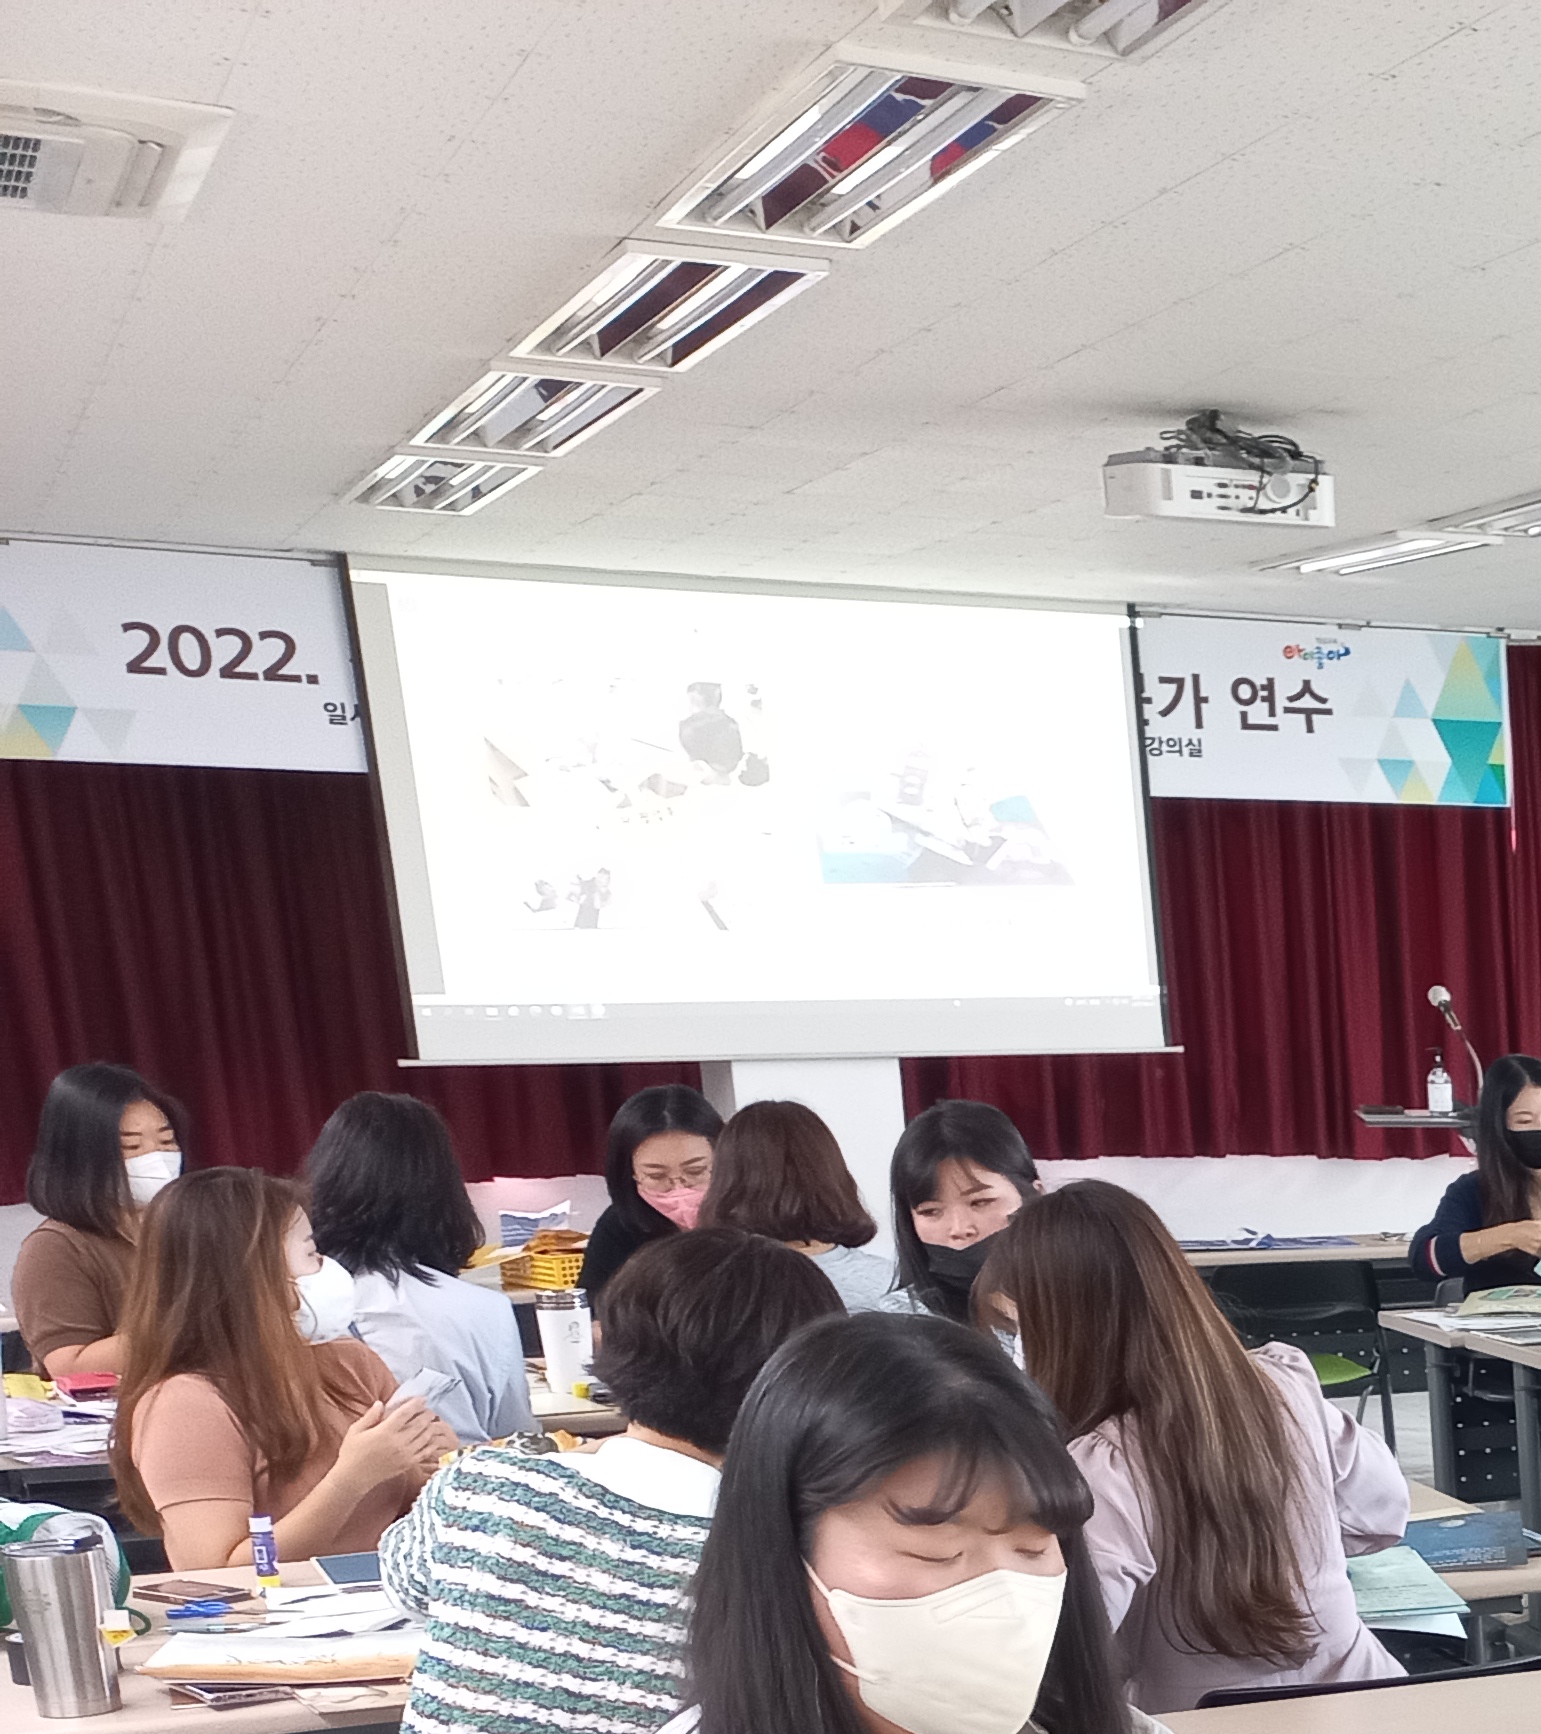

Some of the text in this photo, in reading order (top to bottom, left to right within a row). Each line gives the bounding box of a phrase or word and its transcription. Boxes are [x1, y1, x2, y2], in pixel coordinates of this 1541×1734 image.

[120, 620, 321, 686] 2022.
[1140, 672, 1334, 734] 가 연수
[1145, 734, 1204, 759] 강의실
